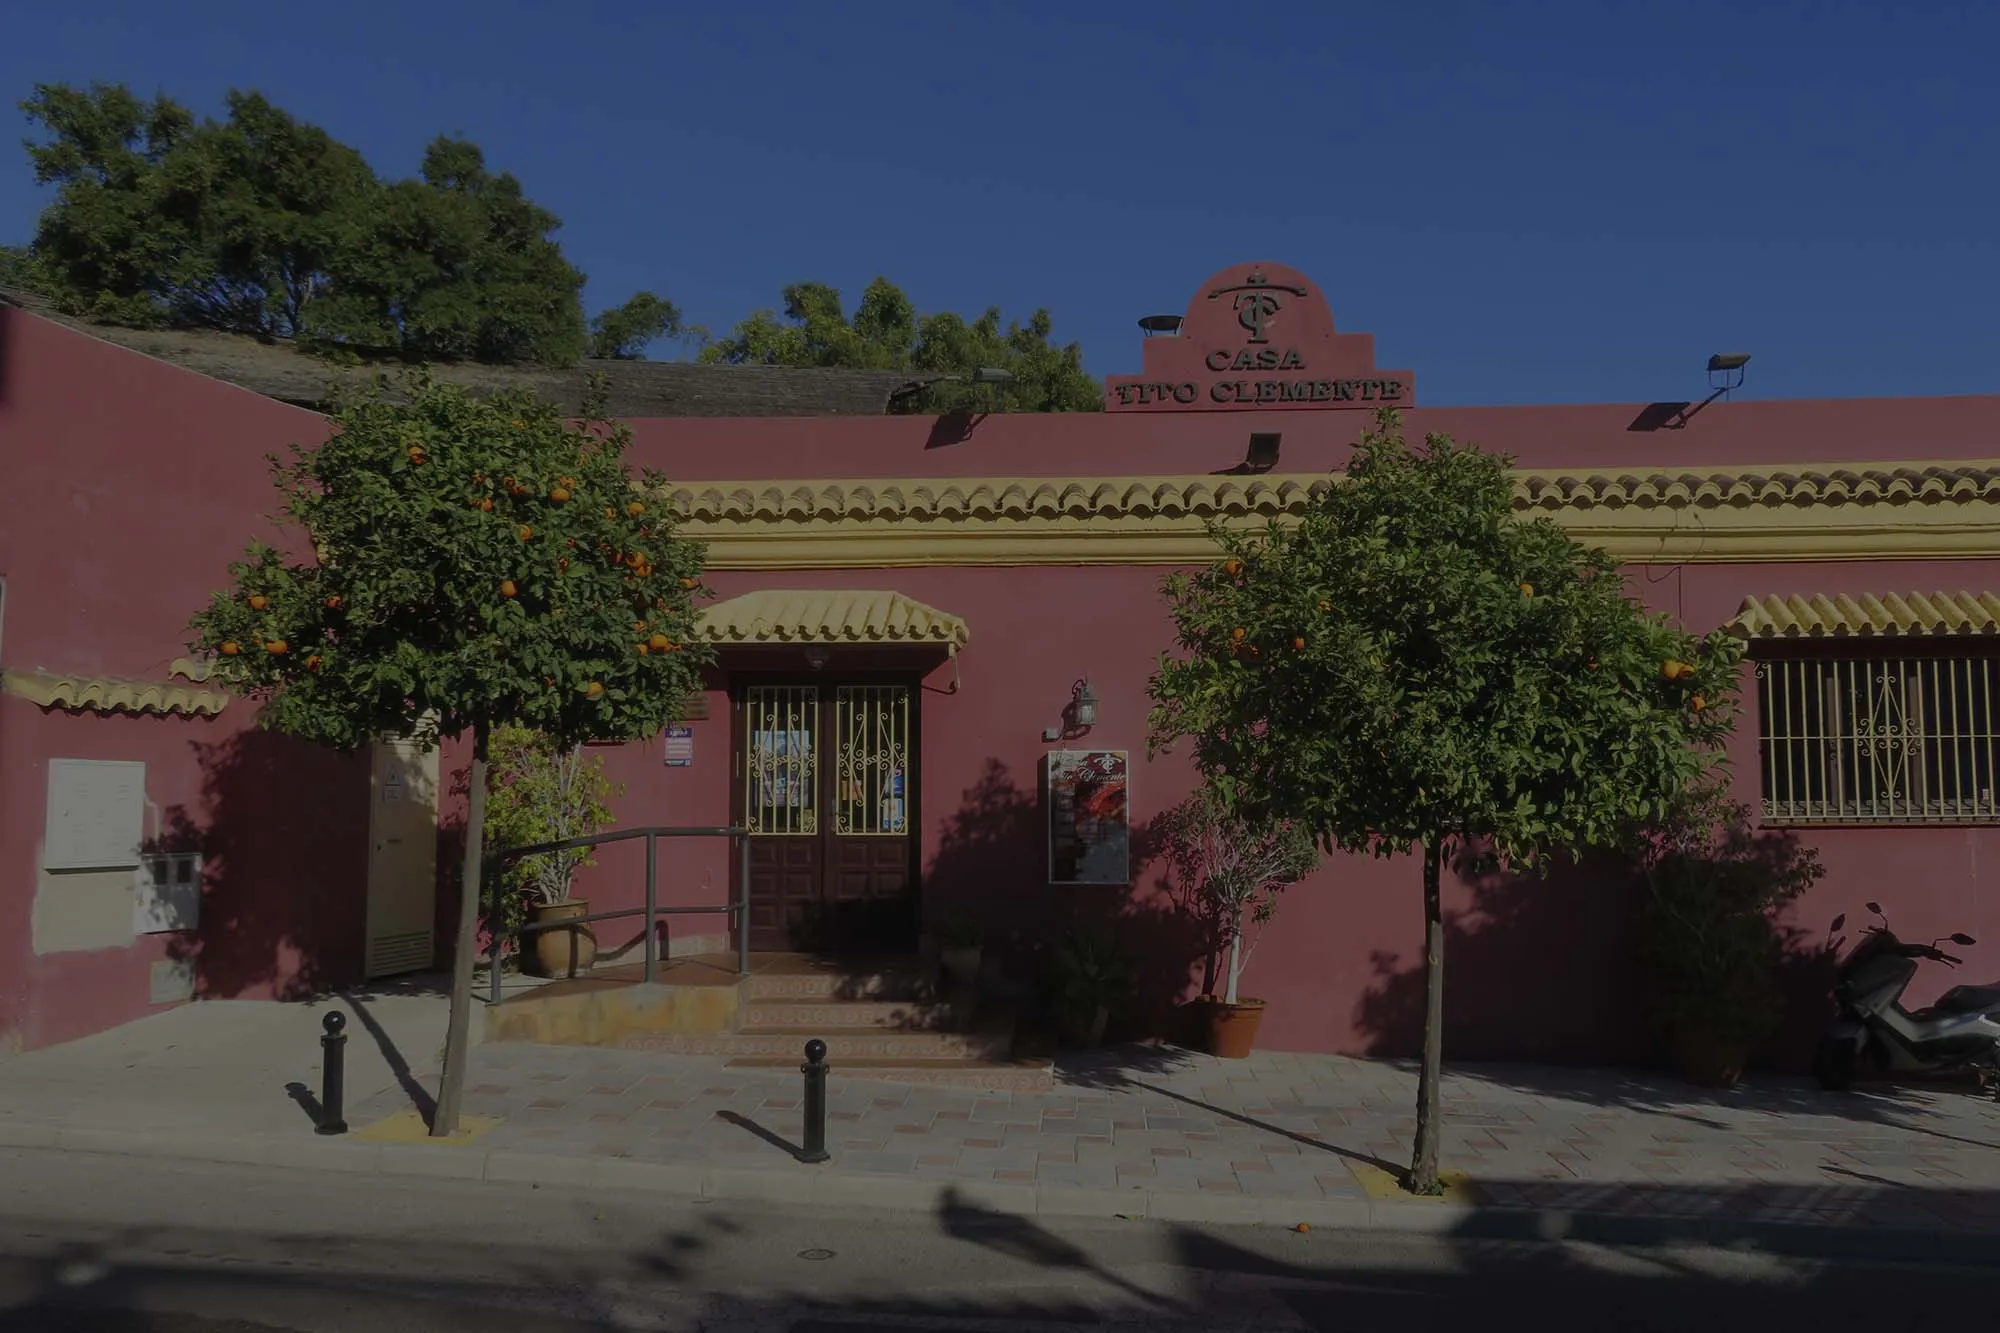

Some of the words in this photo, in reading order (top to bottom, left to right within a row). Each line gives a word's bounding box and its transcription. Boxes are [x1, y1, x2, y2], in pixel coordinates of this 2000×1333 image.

[1205, 349, 1306, 371] CASA
[1116, 381, 1199, 405] TITO
[1210, 378, 1402, 403] CLEMENTE
